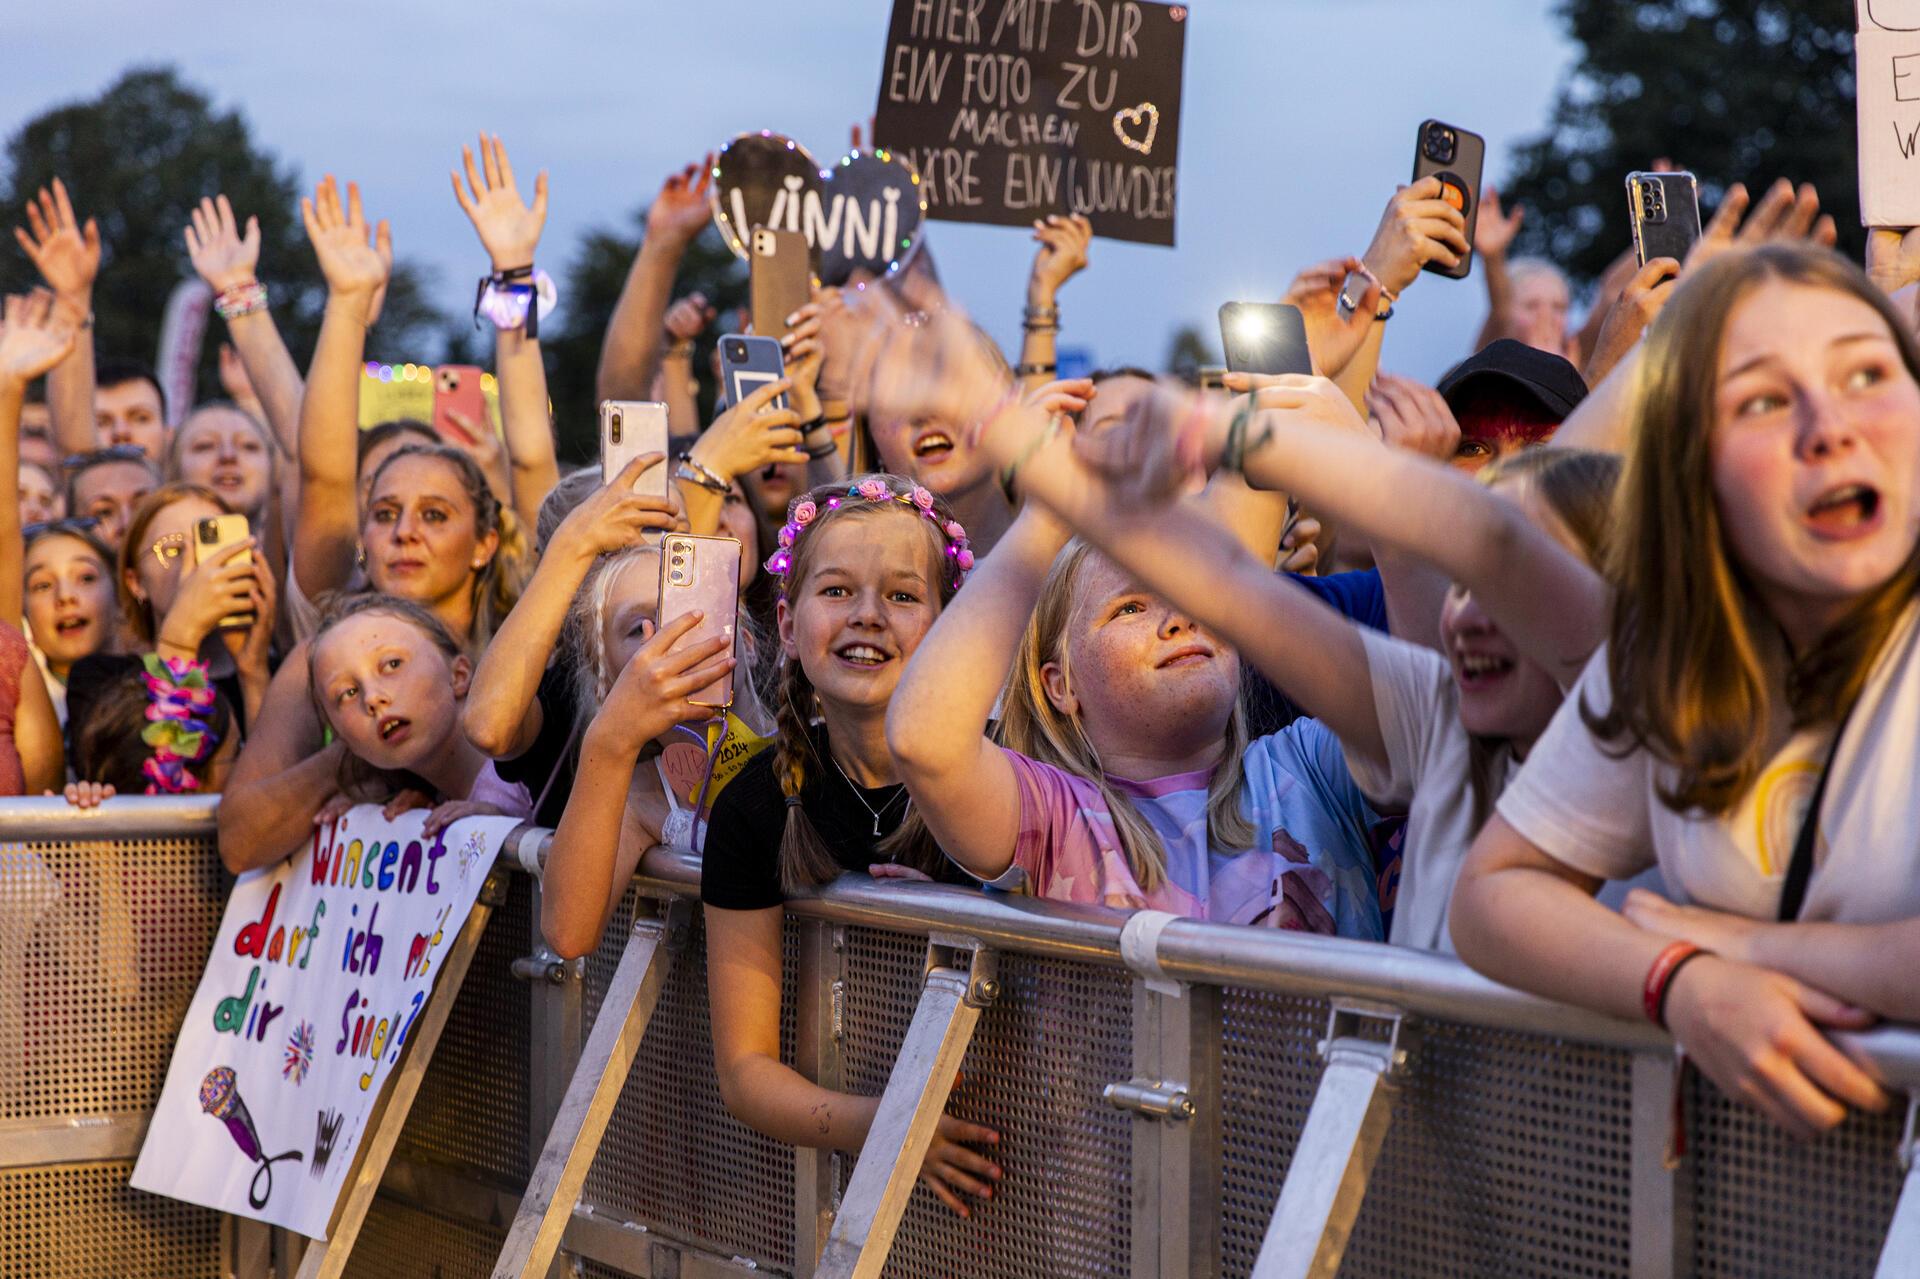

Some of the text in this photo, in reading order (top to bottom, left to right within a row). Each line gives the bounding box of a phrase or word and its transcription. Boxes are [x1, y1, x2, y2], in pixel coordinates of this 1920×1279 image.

[910, 0, 1142, 58] HIER MIT DIR
[889, 45, 1118, 111] EIN FOTO ZU
[949, 107, 1080, 147] MACHEN
[909, 147, 984, 206] ÄRE
[1003, 153, 1062, 209] EIN
[311, 815, 448, 895] Wincent
[234, 882, 326, 969] darf
[342, 901, 383, 977] ich
[214, 966, 283, 1042] dir
